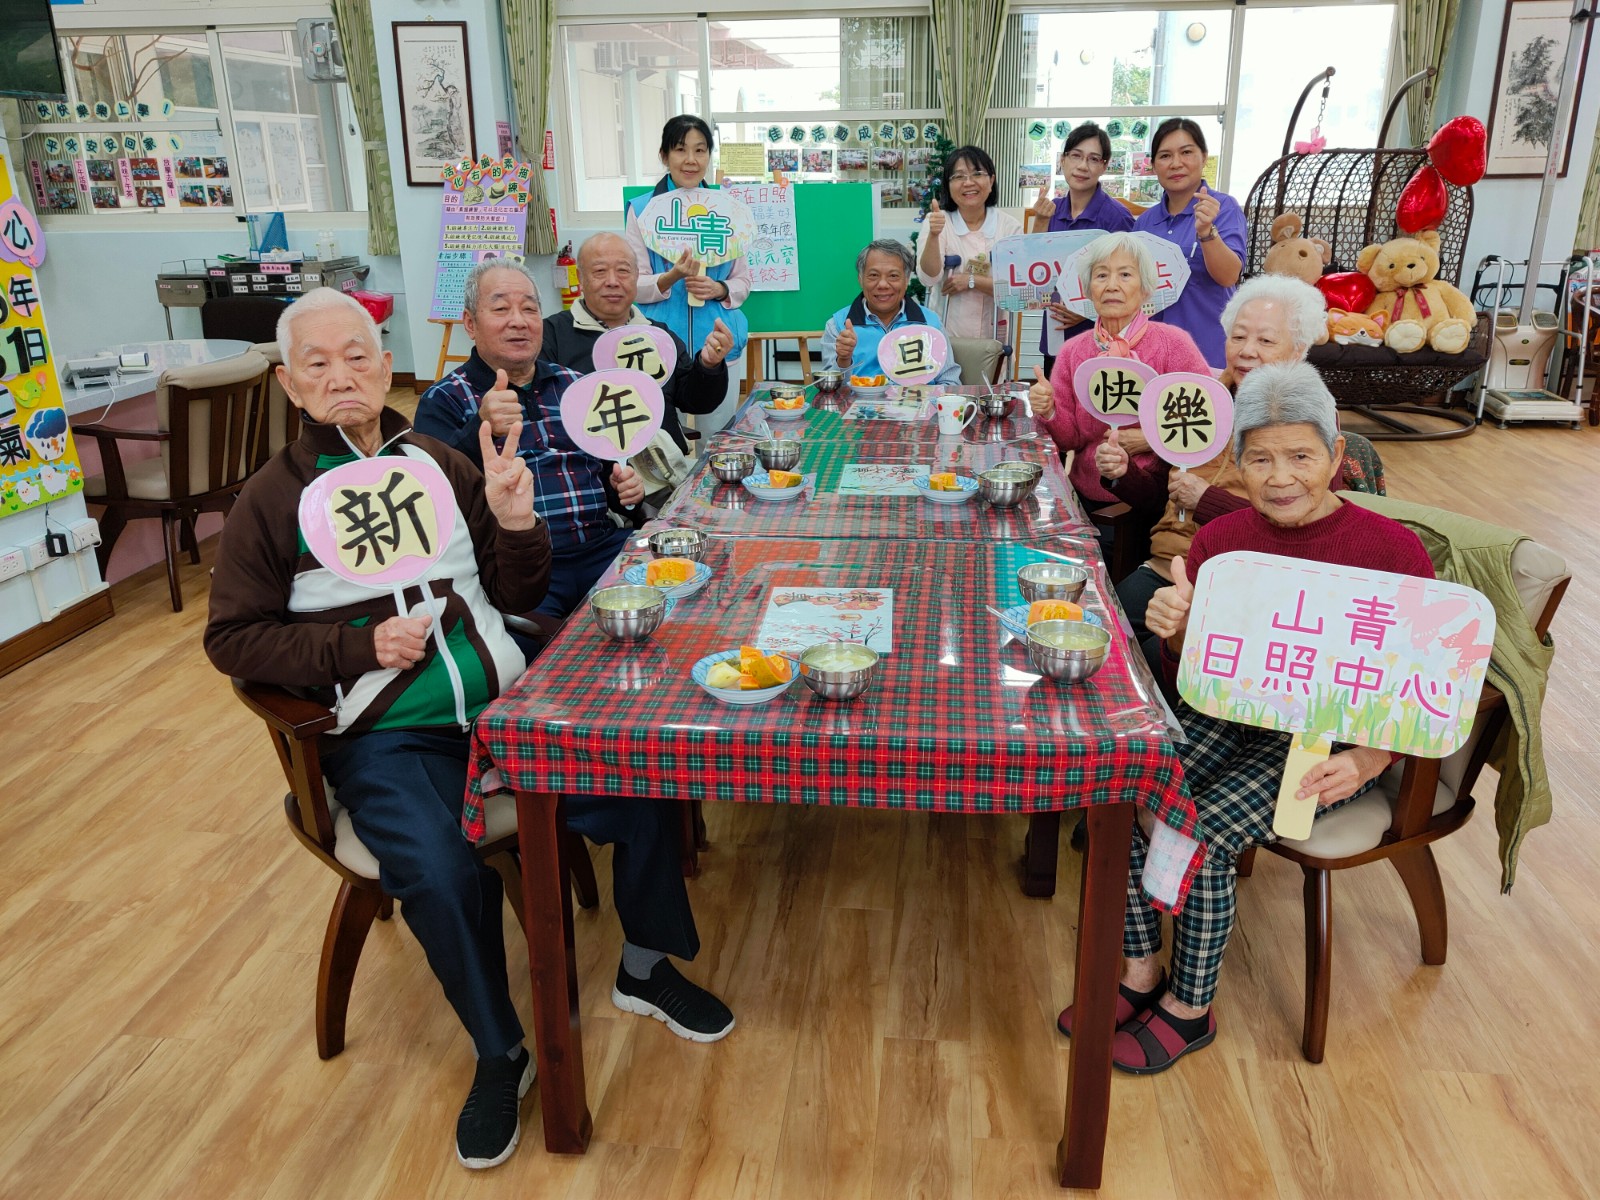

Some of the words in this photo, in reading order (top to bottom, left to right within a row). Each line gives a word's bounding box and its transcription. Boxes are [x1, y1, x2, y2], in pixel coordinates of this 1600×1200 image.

[768, 123, 938, 142] 佳節活動成果發表
[444, 194, 459, 203] 目的
[4, 209, 34, 250] 心
[655, 197, 734, 257] 山青
[617, 337, 667, 381] 元
[894, 339, 935, 376] 旦
[587, 384, 651, 451] 年
[1094, 370, 1142, 413] 快
[1160, 386, 1213, 448] 樂
[334, 471, 431, 567] 新
[1271, 589, 1397, 651] 山青
[1202, 633, 1452, 719] 日照中心
